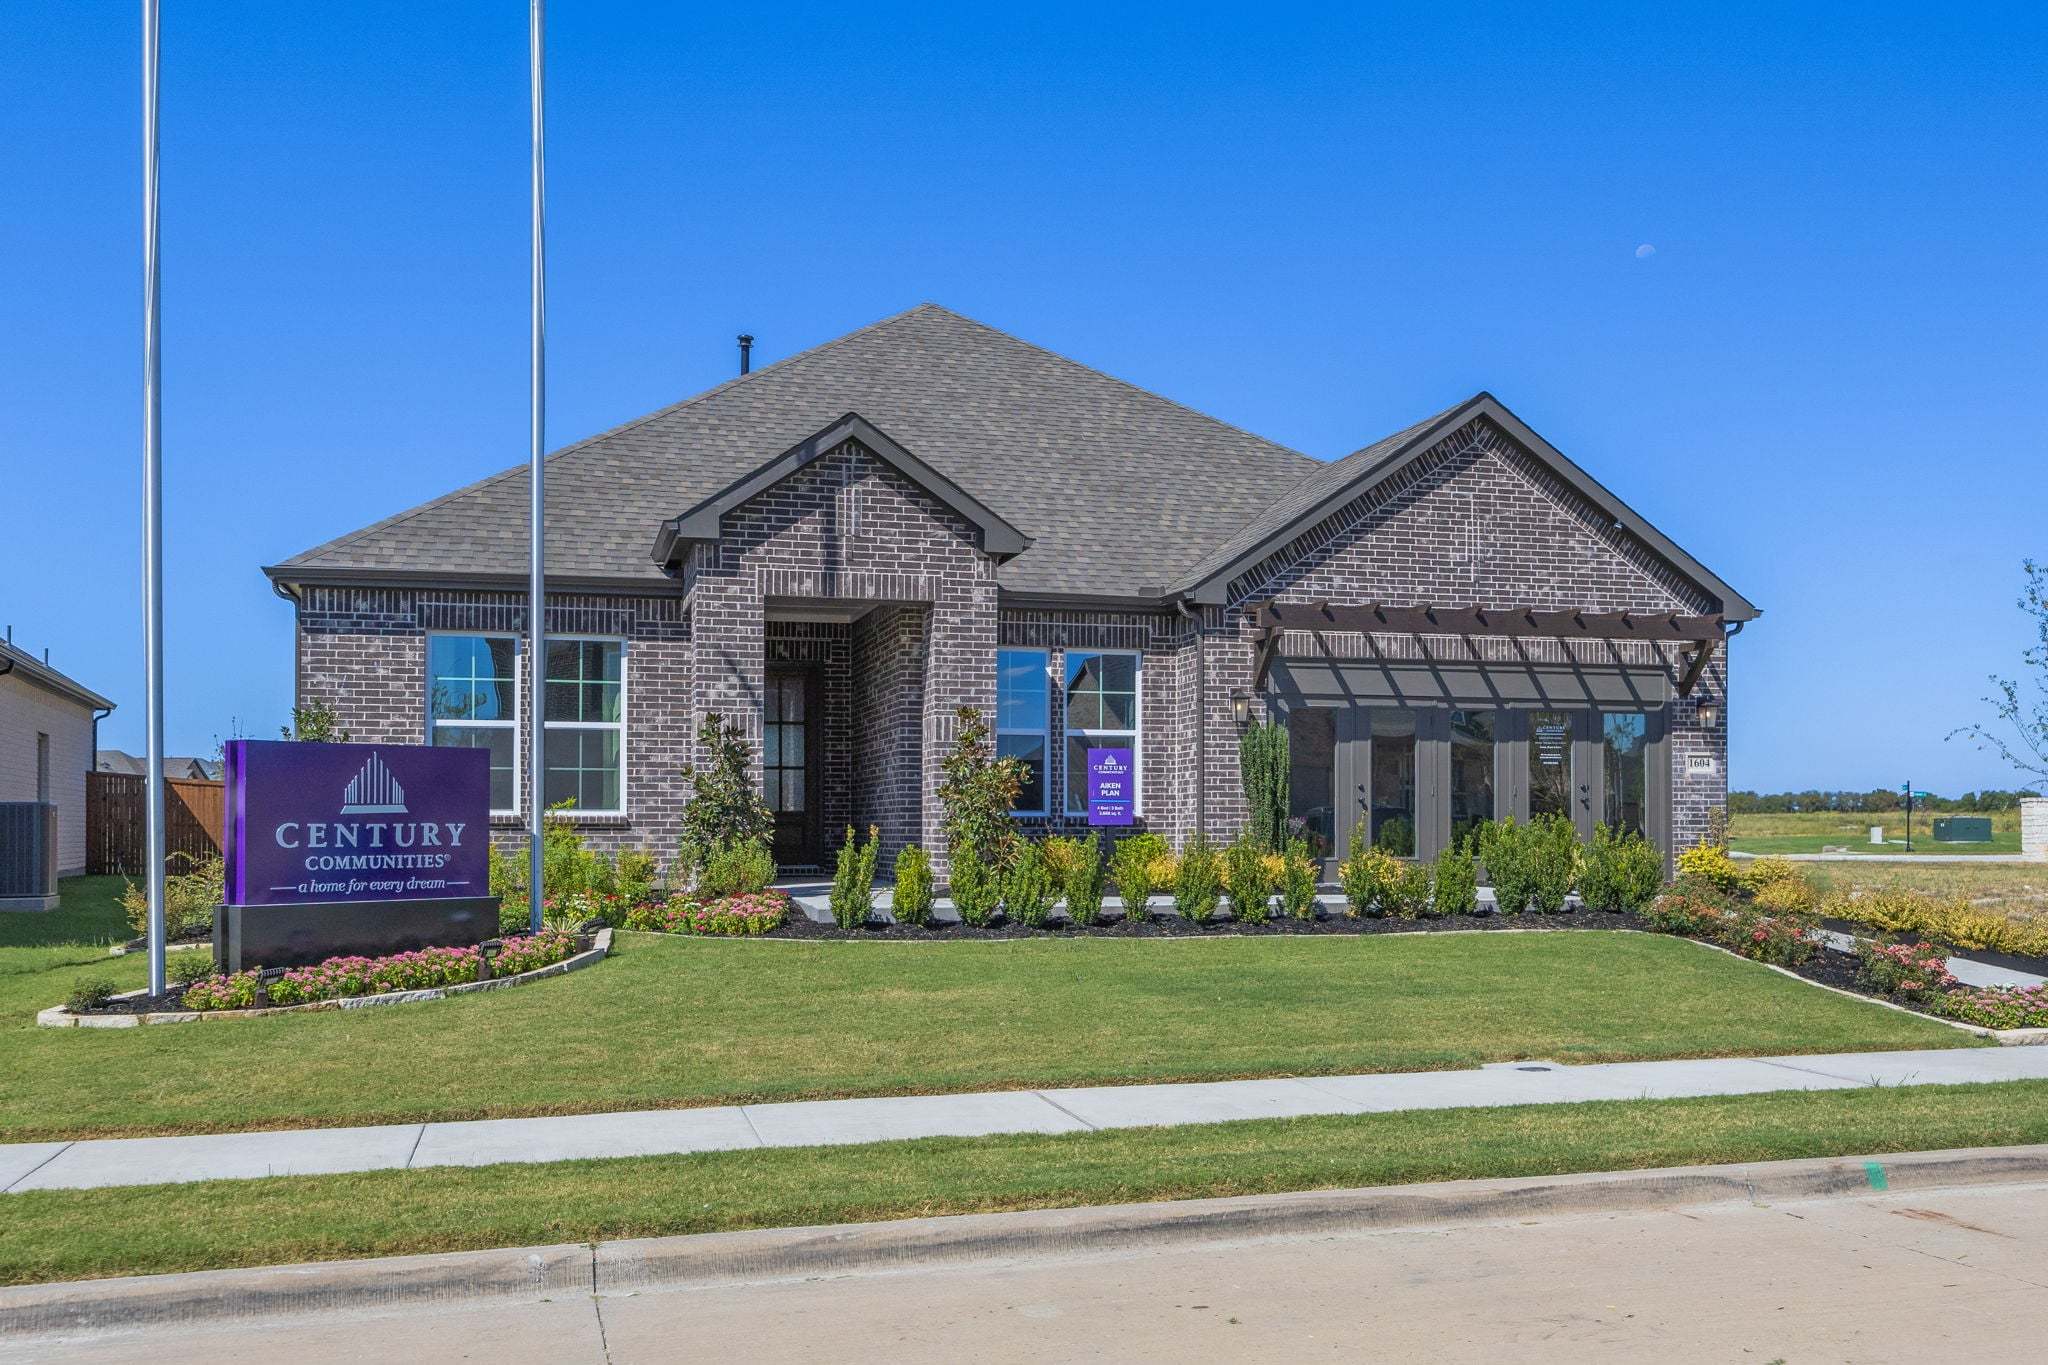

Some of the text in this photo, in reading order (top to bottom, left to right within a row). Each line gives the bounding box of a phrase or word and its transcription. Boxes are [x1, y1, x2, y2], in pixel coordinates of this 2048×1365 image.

[1690, 758, 1710, 767] 1604
[275, 822, 466, 849] CENTURY
[298, 876, 446, 895] a home for every dream
